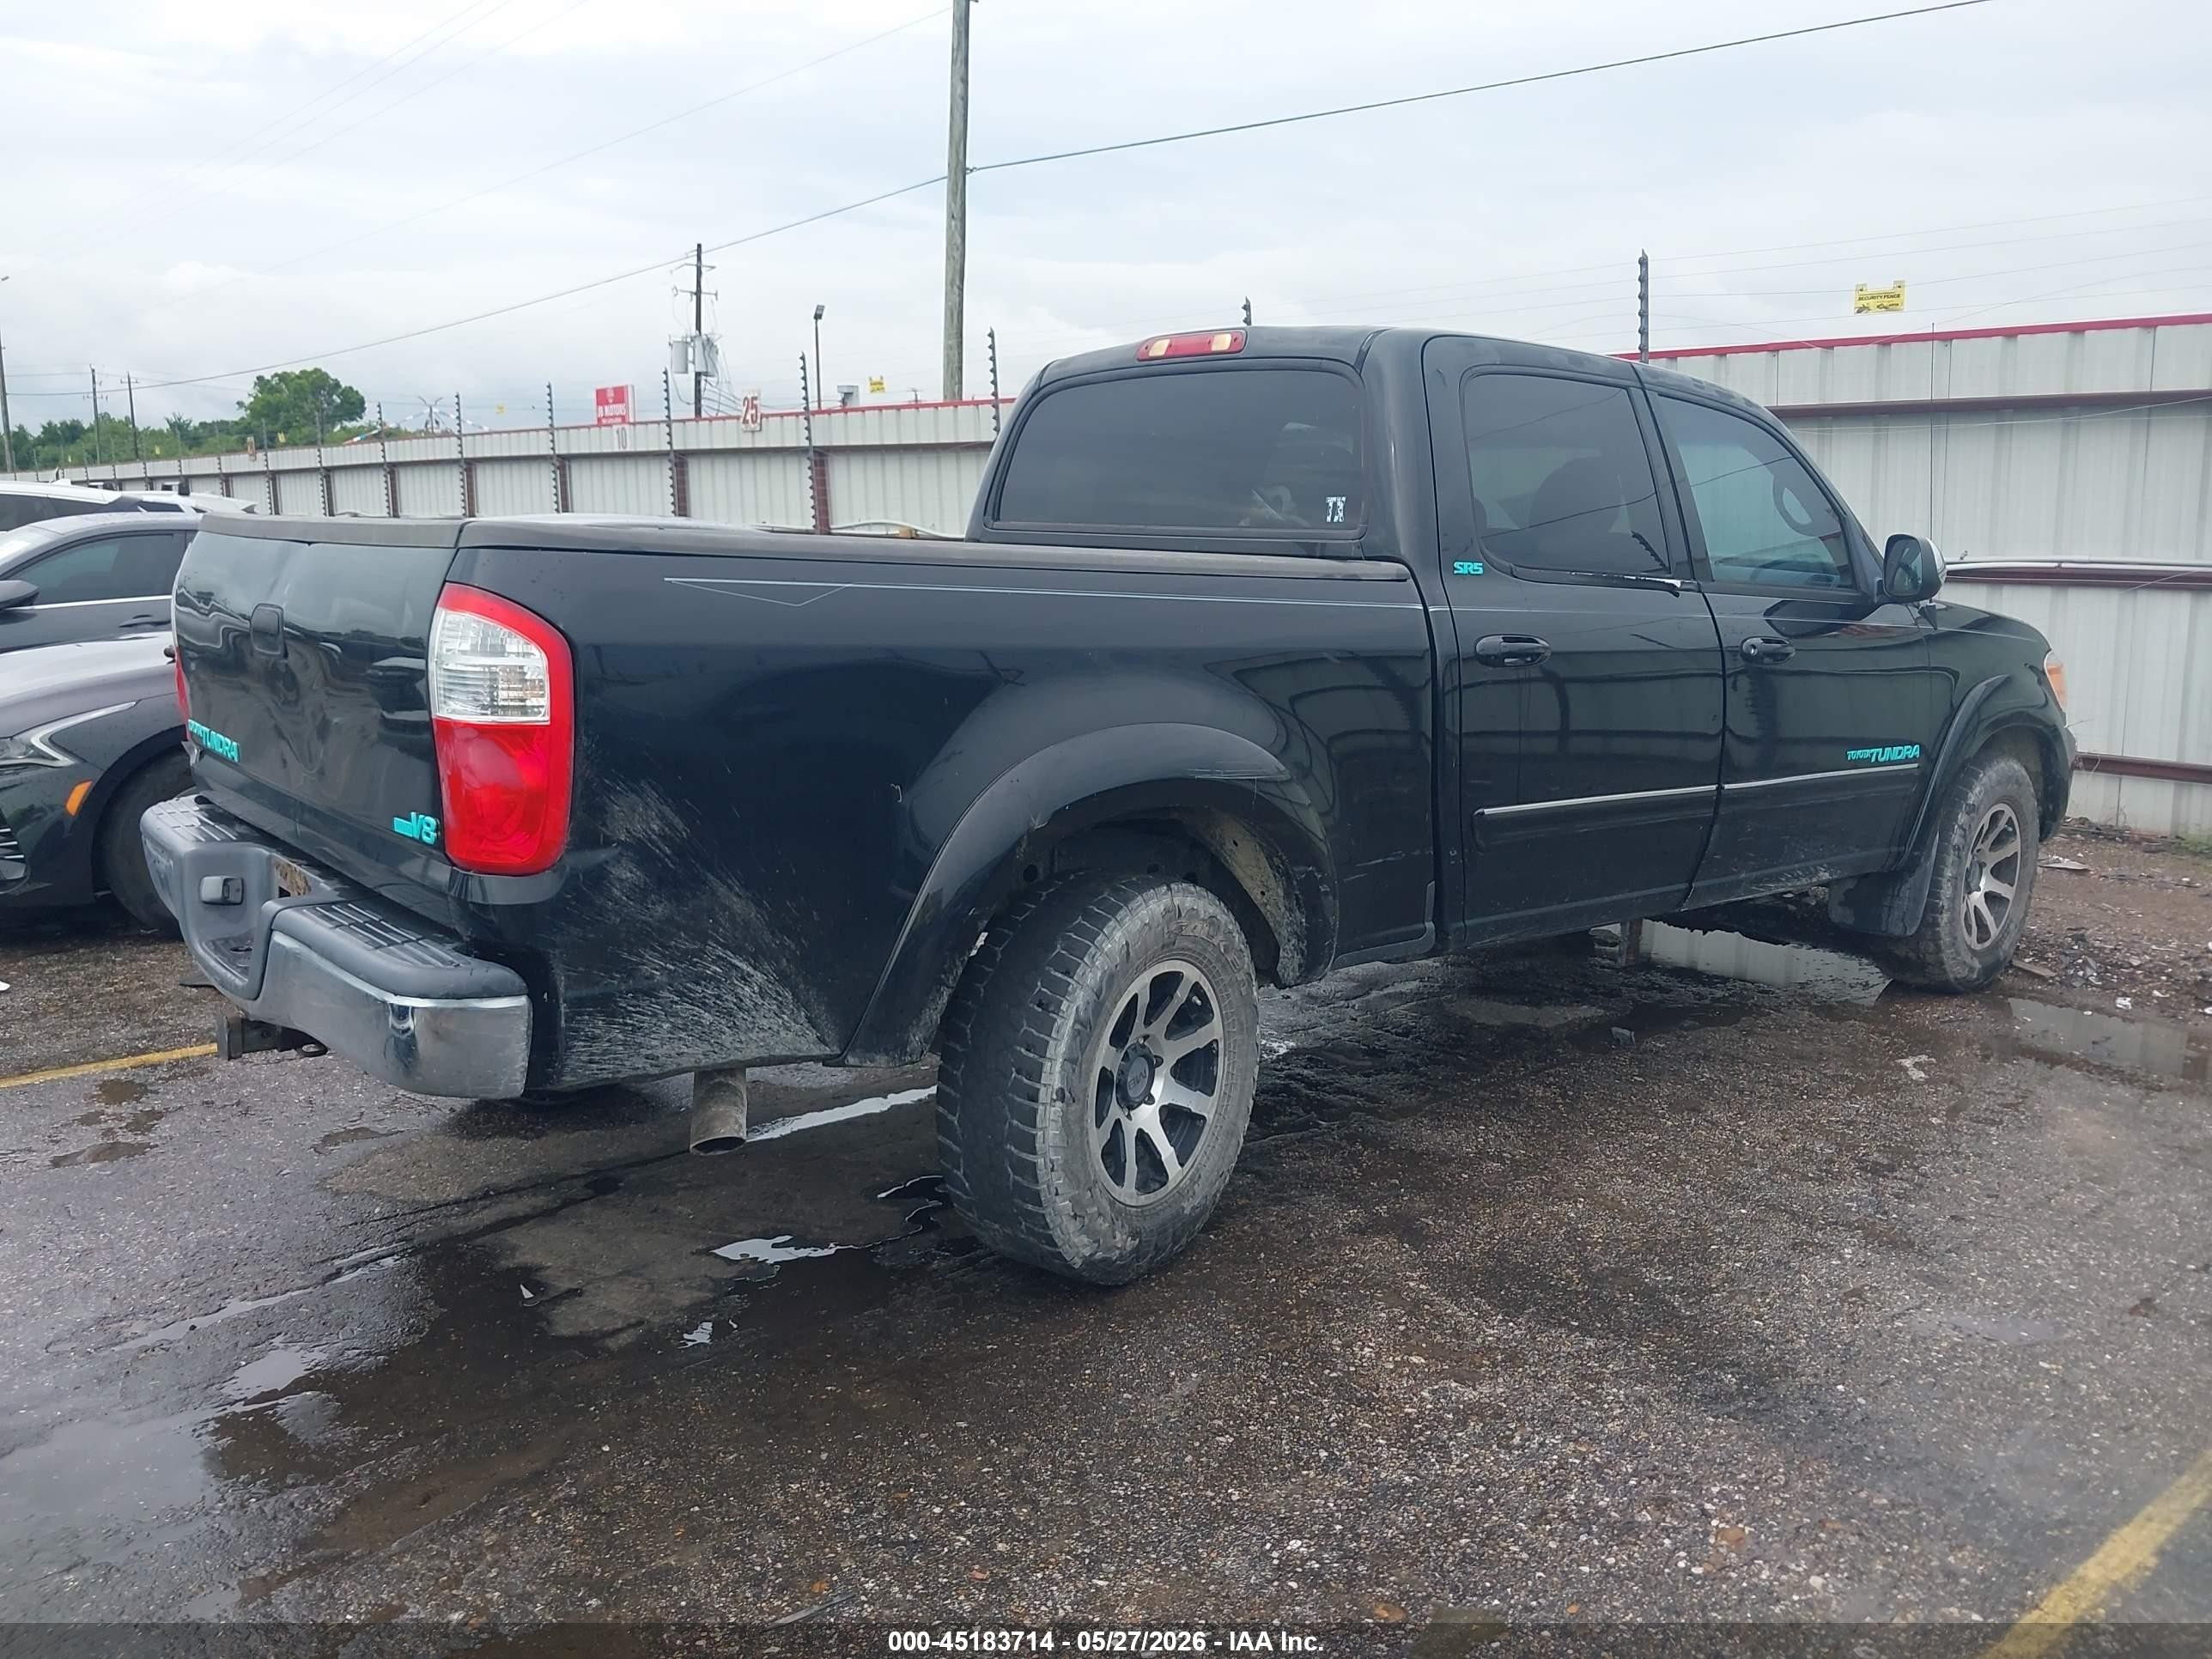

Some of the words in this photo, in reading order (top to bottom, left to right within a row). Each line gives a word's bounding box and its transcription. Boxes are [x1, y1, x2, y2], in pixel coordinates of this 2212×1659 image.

[742, 396, 759, 424] 25
[616, 427, 628, 450] 10
[1326, 496, 1346, 523] TX
[1453, 562, 1484, 574] SR5
[201, 726, 240, 763] TUNDRA
[1847, 749, 1872, 761] TOYOTA
[1869, 744, 1921, 763] TUNDRA
[410, 811, 437, 845] V8
